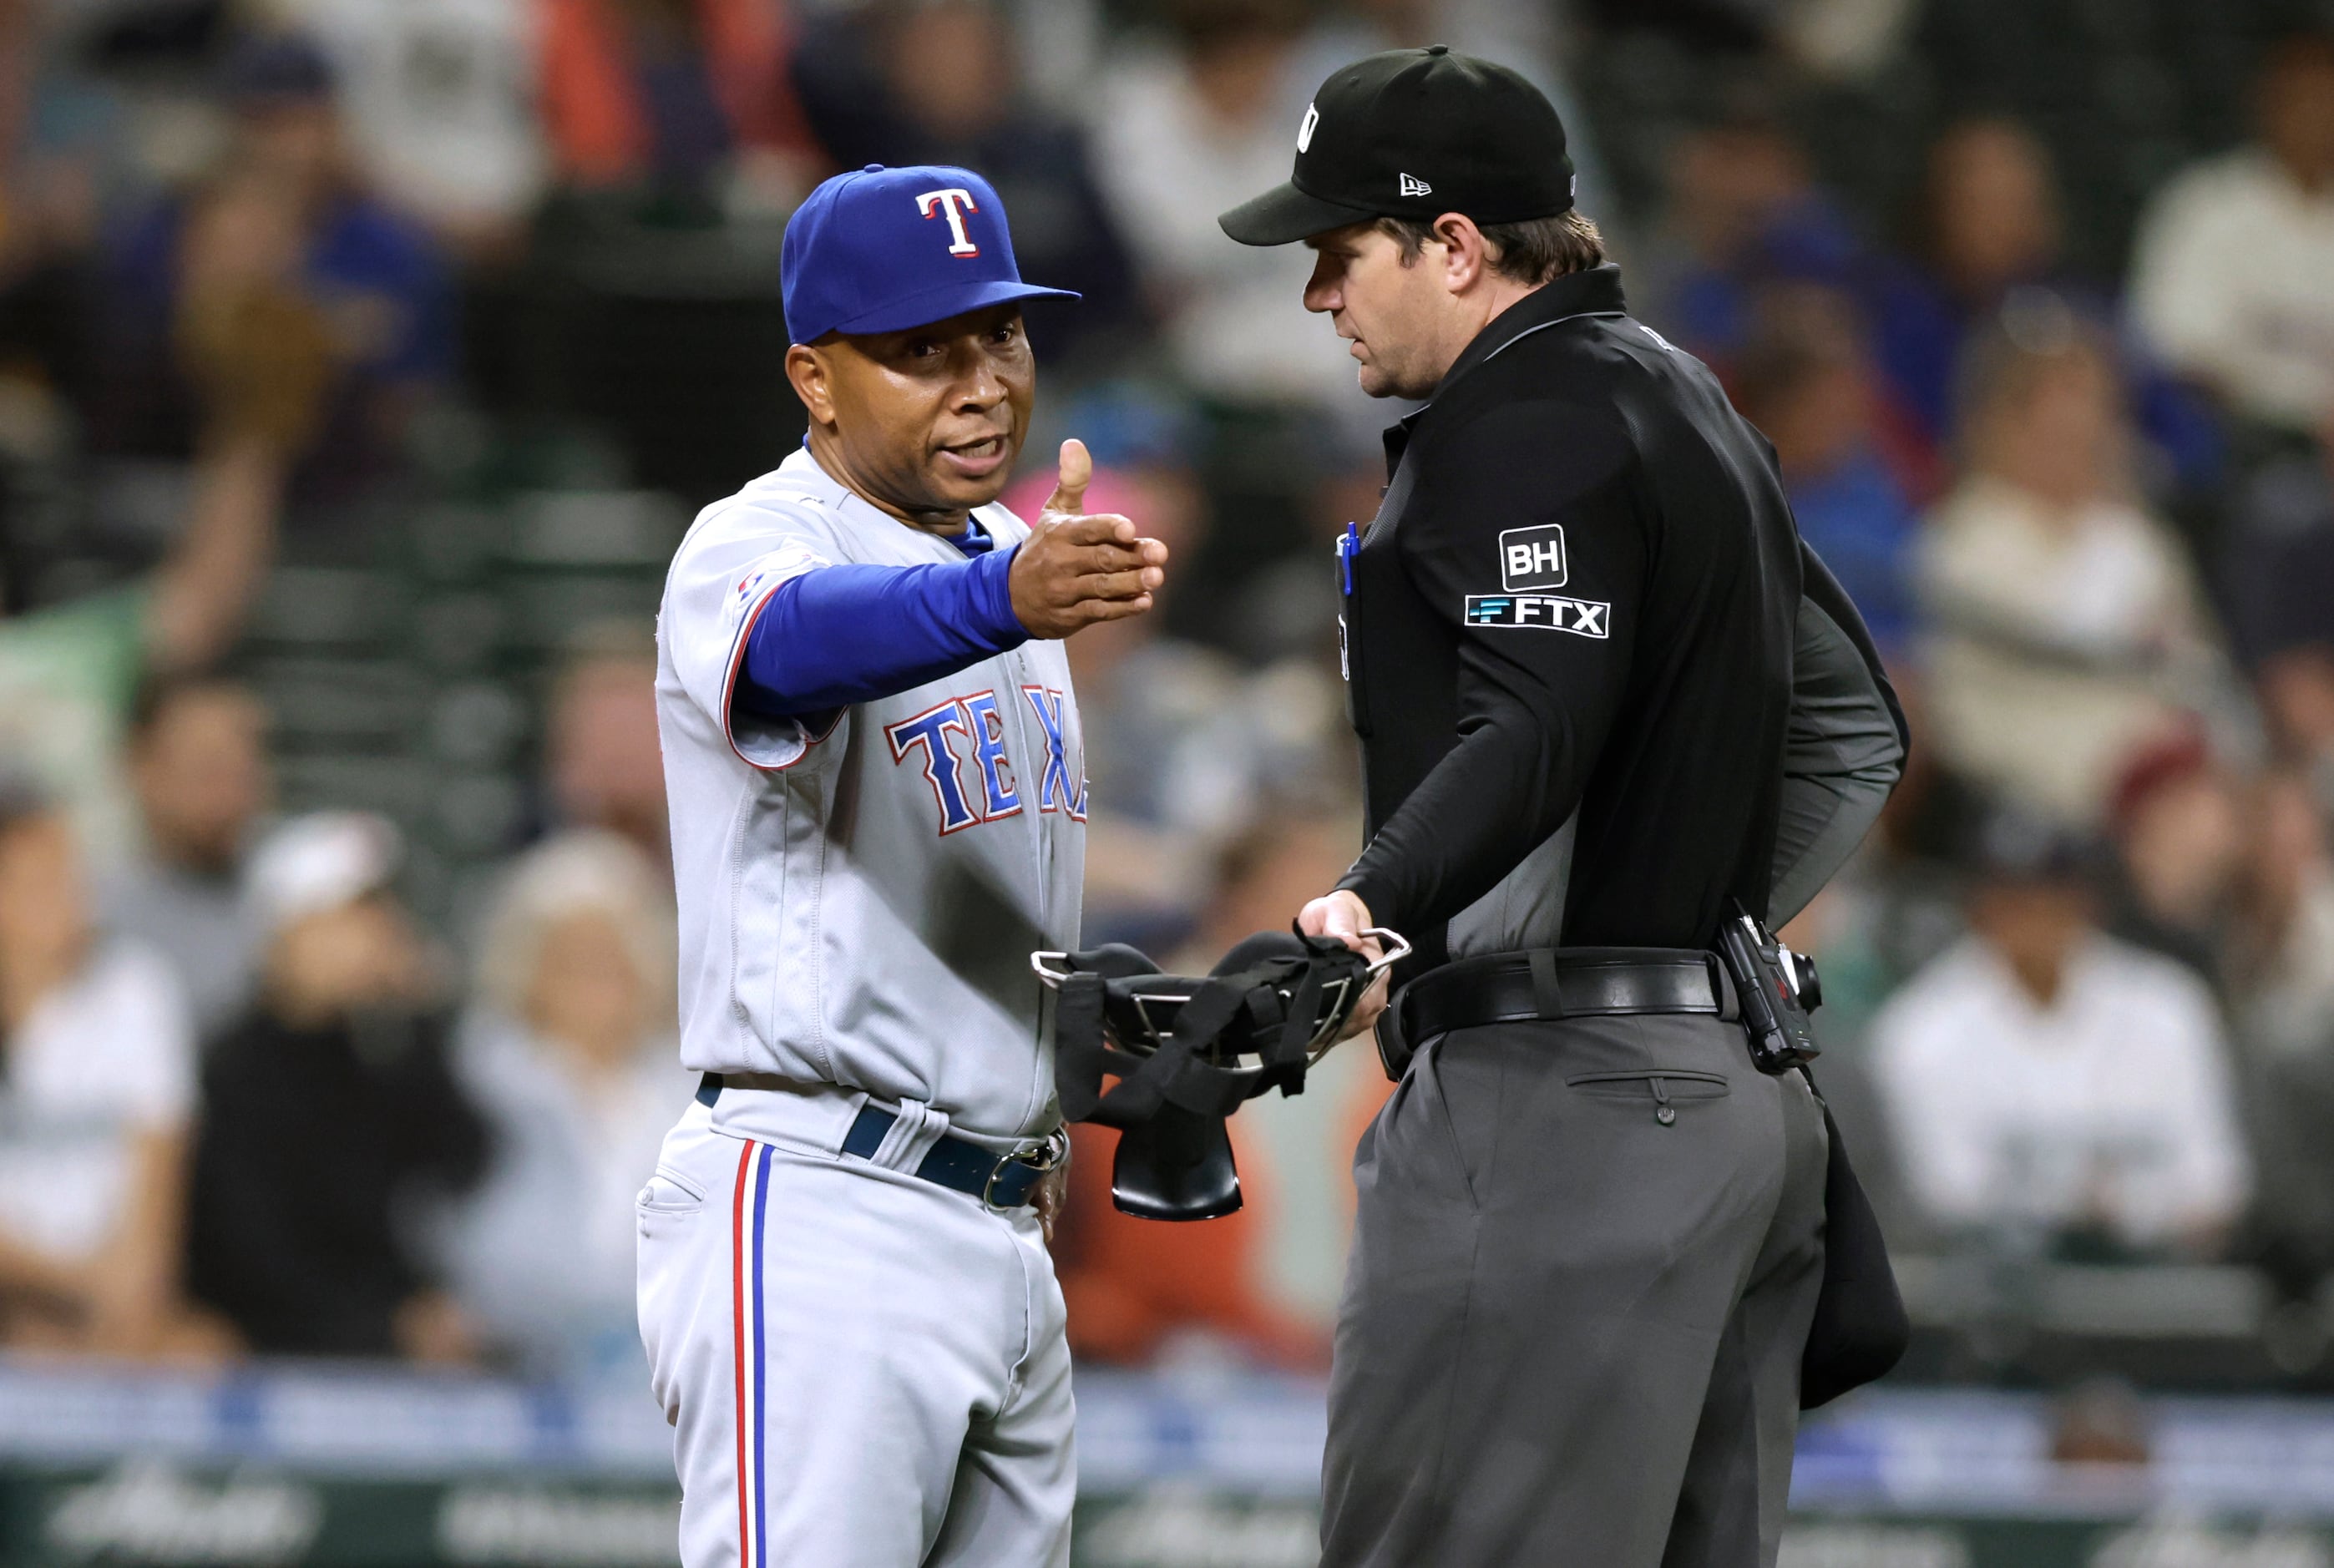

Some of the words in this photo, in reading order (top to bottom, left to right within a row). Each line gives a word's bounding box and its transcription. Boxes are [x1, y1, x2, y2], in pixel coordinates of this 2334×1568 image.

[915, 188, 980, 258] T
[1507, 539, 1559, 577] BH
[1515, 597, 1604, 635] FTX
